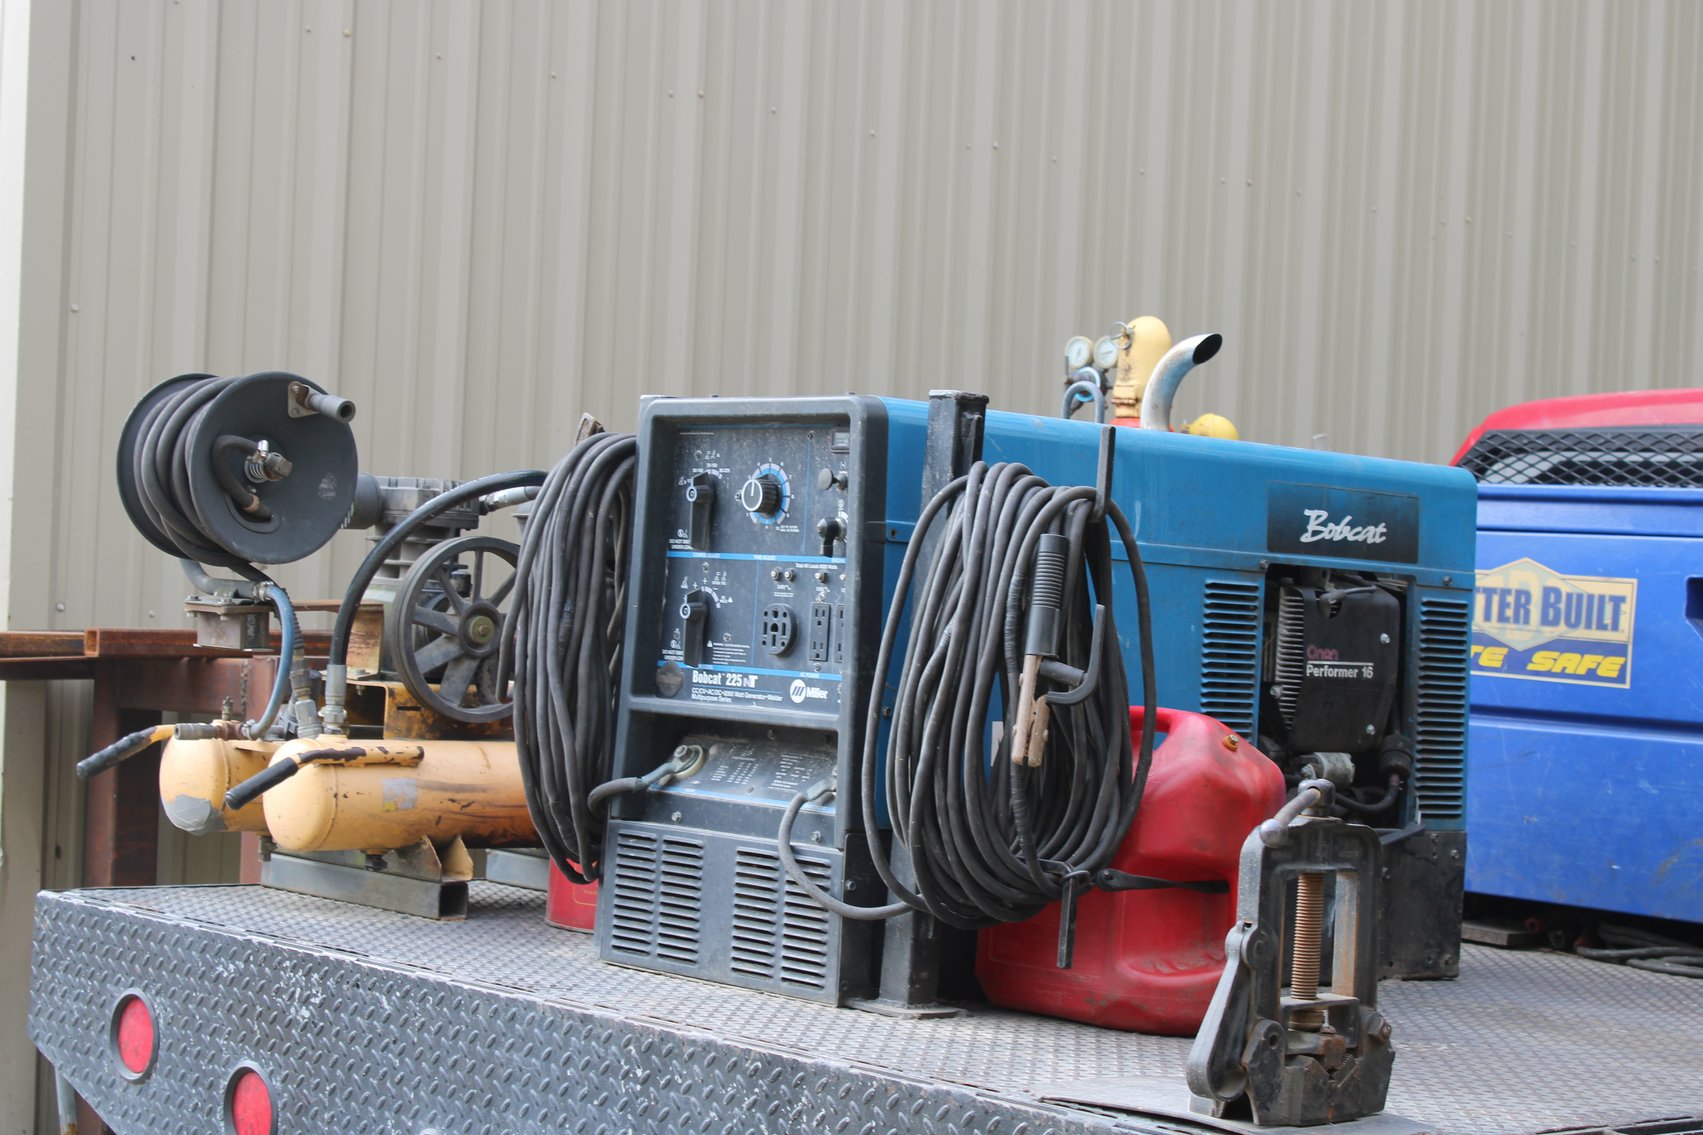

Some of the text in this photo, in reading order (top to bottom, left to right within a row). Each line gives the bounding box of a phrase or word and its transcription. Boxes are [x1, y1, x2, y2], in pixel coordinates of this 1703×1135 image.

[1300, 508, 1388, 544] Bobcat
[1475, 586, 1627, 632] TER BUILT
[1306, 664, 1374, 679] Performer 16
[1526, 650, 1626, 678] SAFE
[726, 673, 743, 687] 225
[806, 686, 828, 700] Miller
